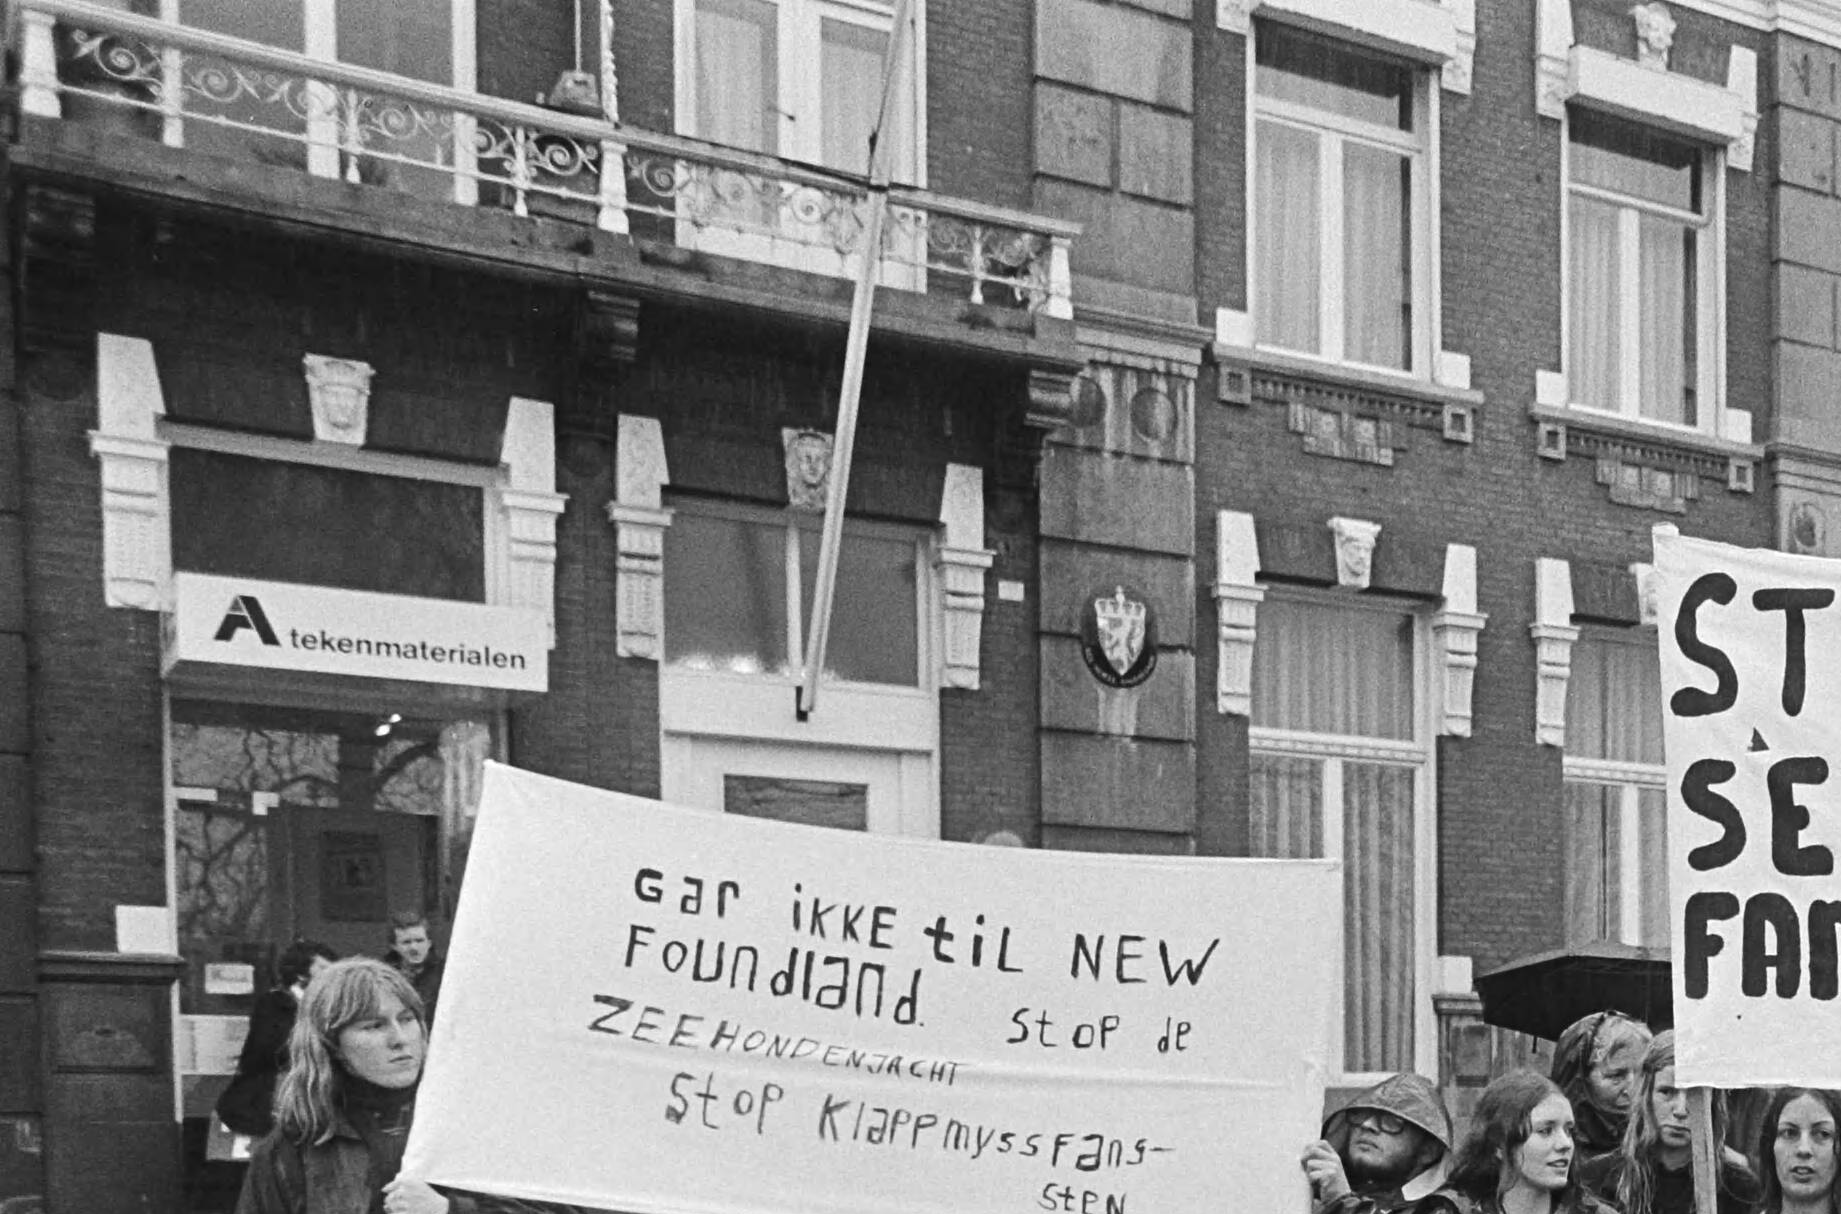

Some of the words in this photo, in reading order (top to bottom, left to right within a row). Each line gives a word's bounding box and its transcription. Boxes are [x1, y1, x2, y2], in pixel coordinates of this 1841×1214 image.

[290, 628, 527, 670] tekenmaterialen
[1070, 931, 1221, 987] NEW
[587, 994, 962, 1086] ZEEHONDENJACHT
